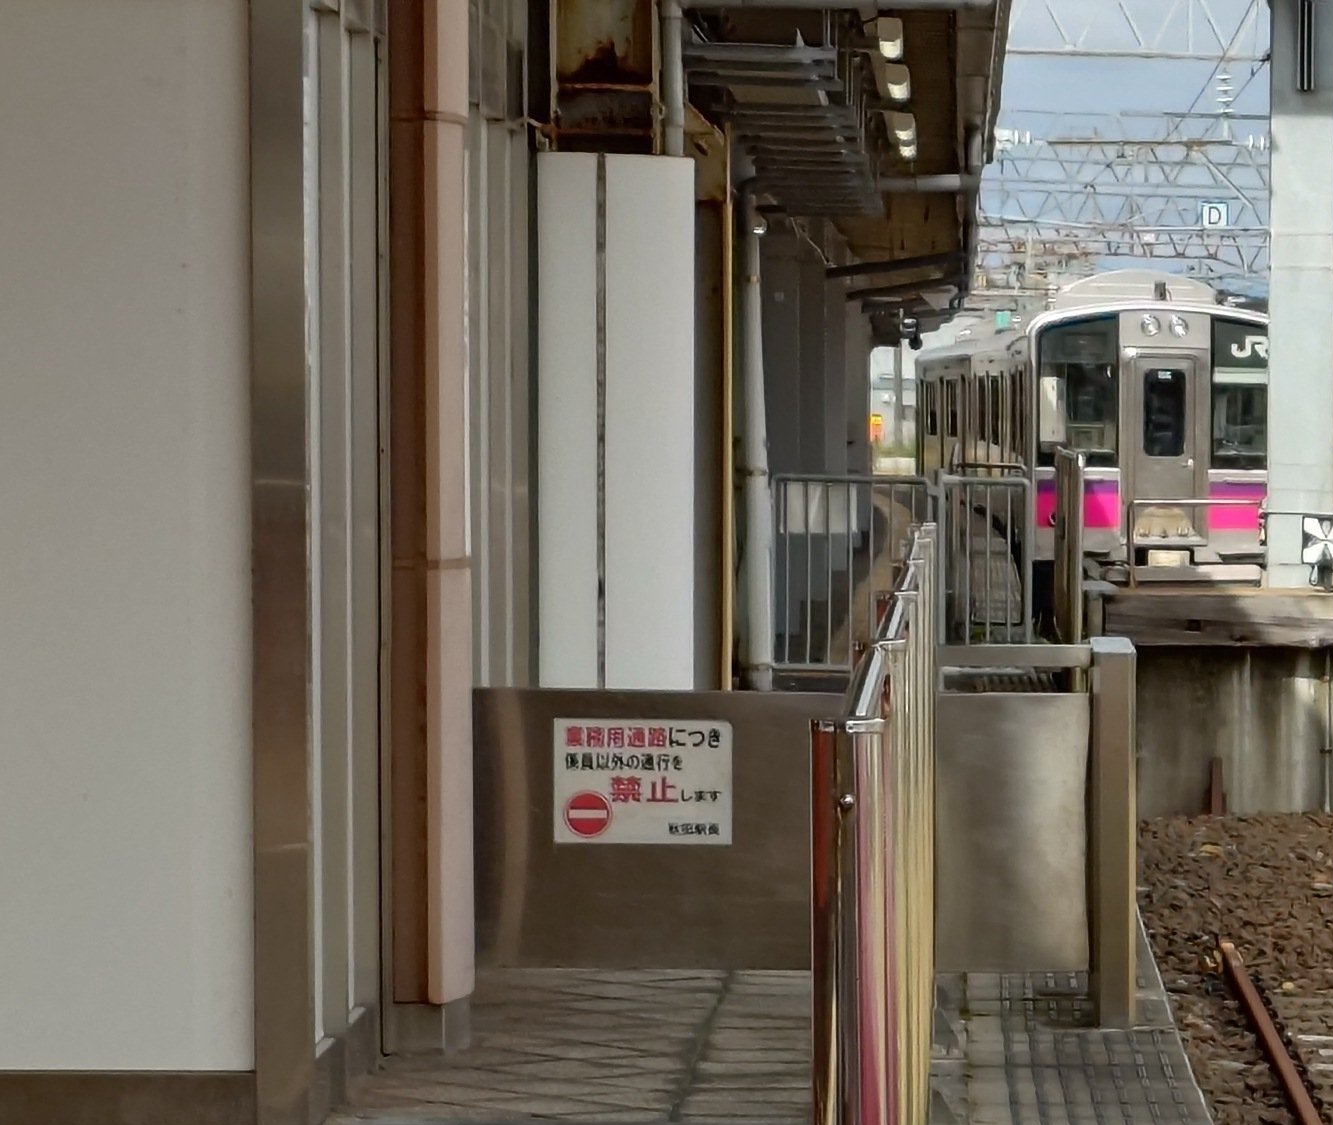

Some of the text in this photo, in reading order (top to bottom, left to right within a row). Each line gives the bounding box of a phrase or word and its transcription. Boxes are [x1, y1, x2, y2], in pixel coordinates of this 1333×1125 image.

[1208, 206, 1222, 225] D
[565, 752, 683, 771] 係員以外の通行を
[610, 775, 722, 803] 禁止します
